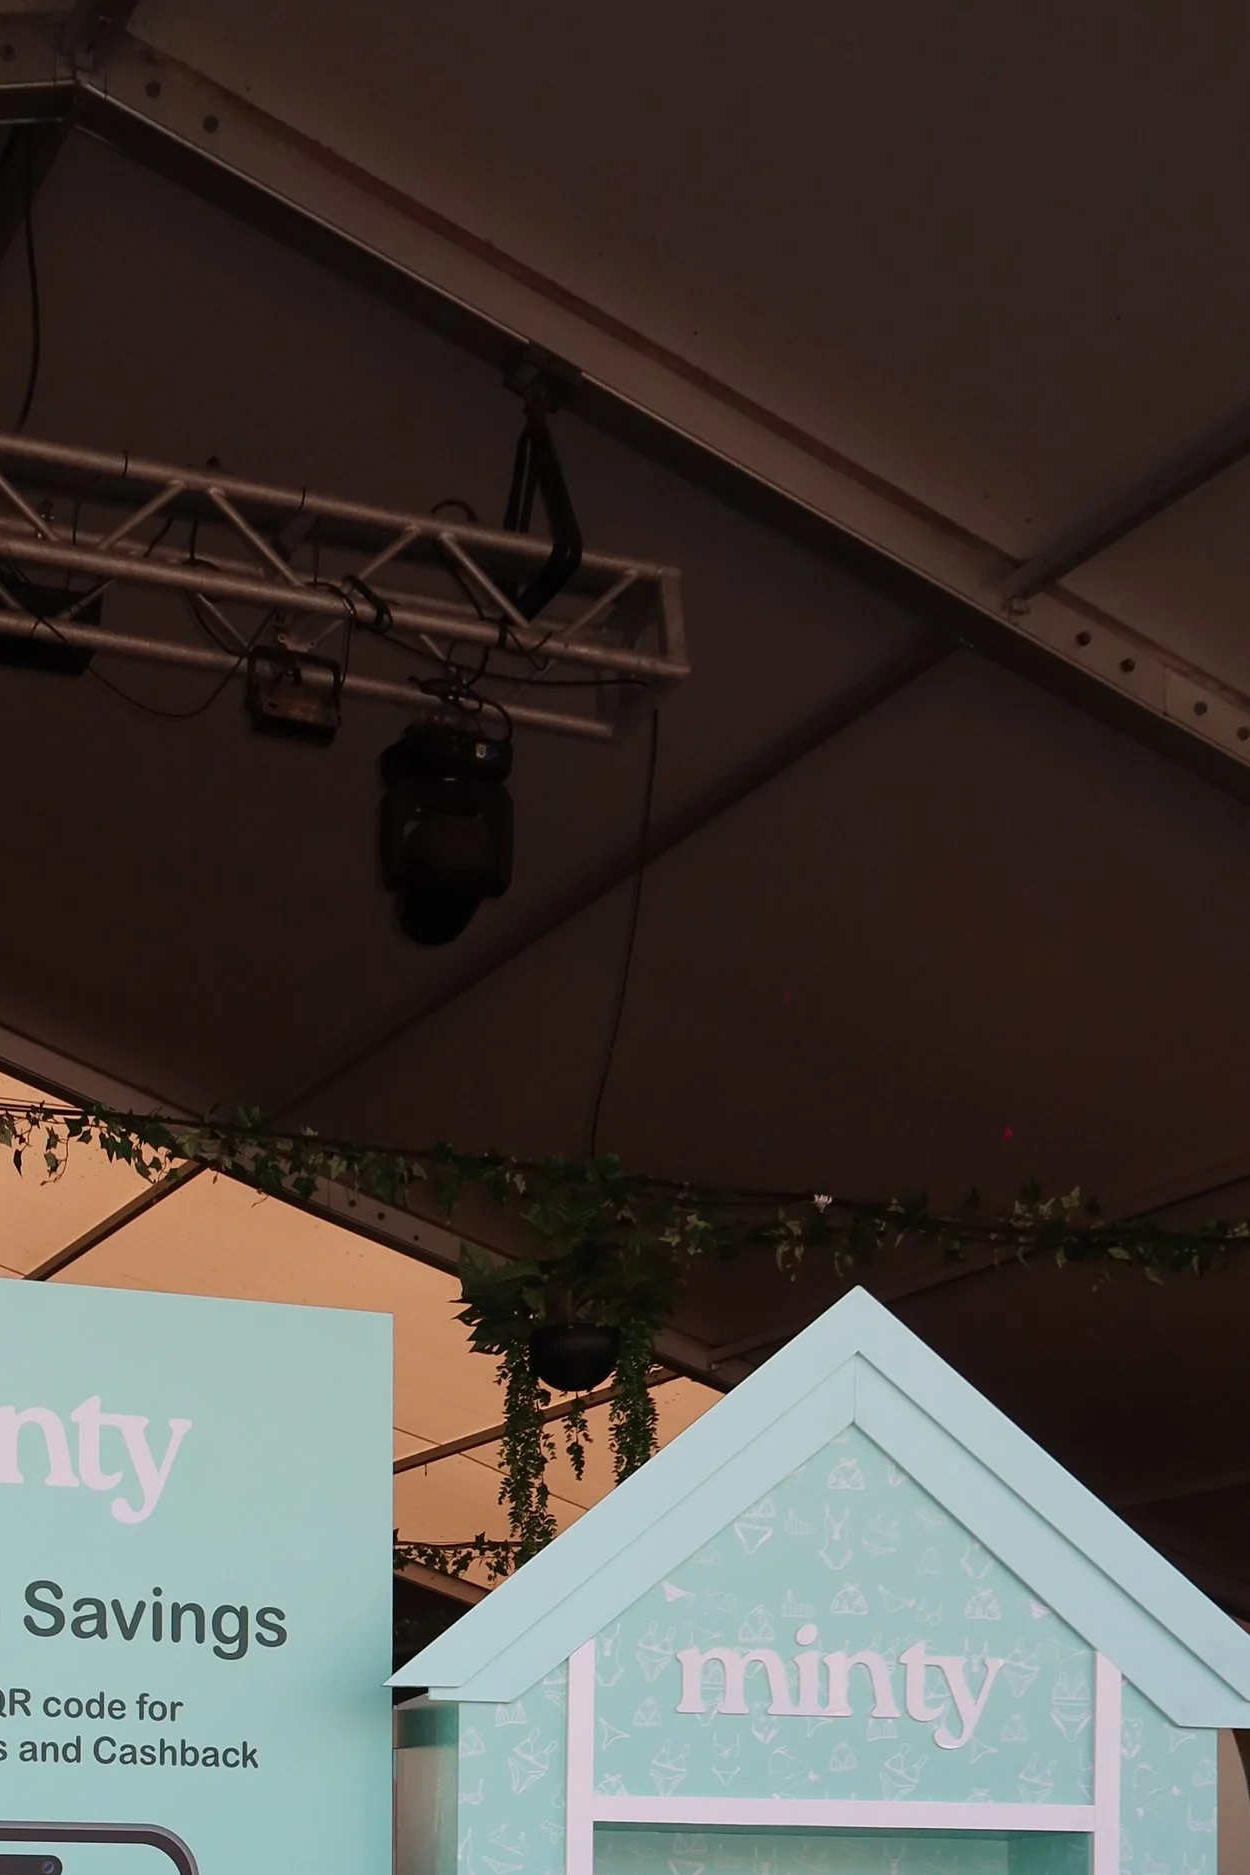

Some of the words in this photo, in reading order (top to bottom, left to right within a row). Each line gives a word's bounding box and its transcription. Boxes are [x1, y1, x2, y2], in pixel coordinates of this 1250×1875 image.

[23, 1579, 289, 1662] Savings
[42, 1691, 127, 1721] code
[135, 1692, 184, 1722] for
[676, 1624, 1002, 1750] minty
[18, 1734, 82, 1764] and
[93, 1735, 259, 1769] Cashback
